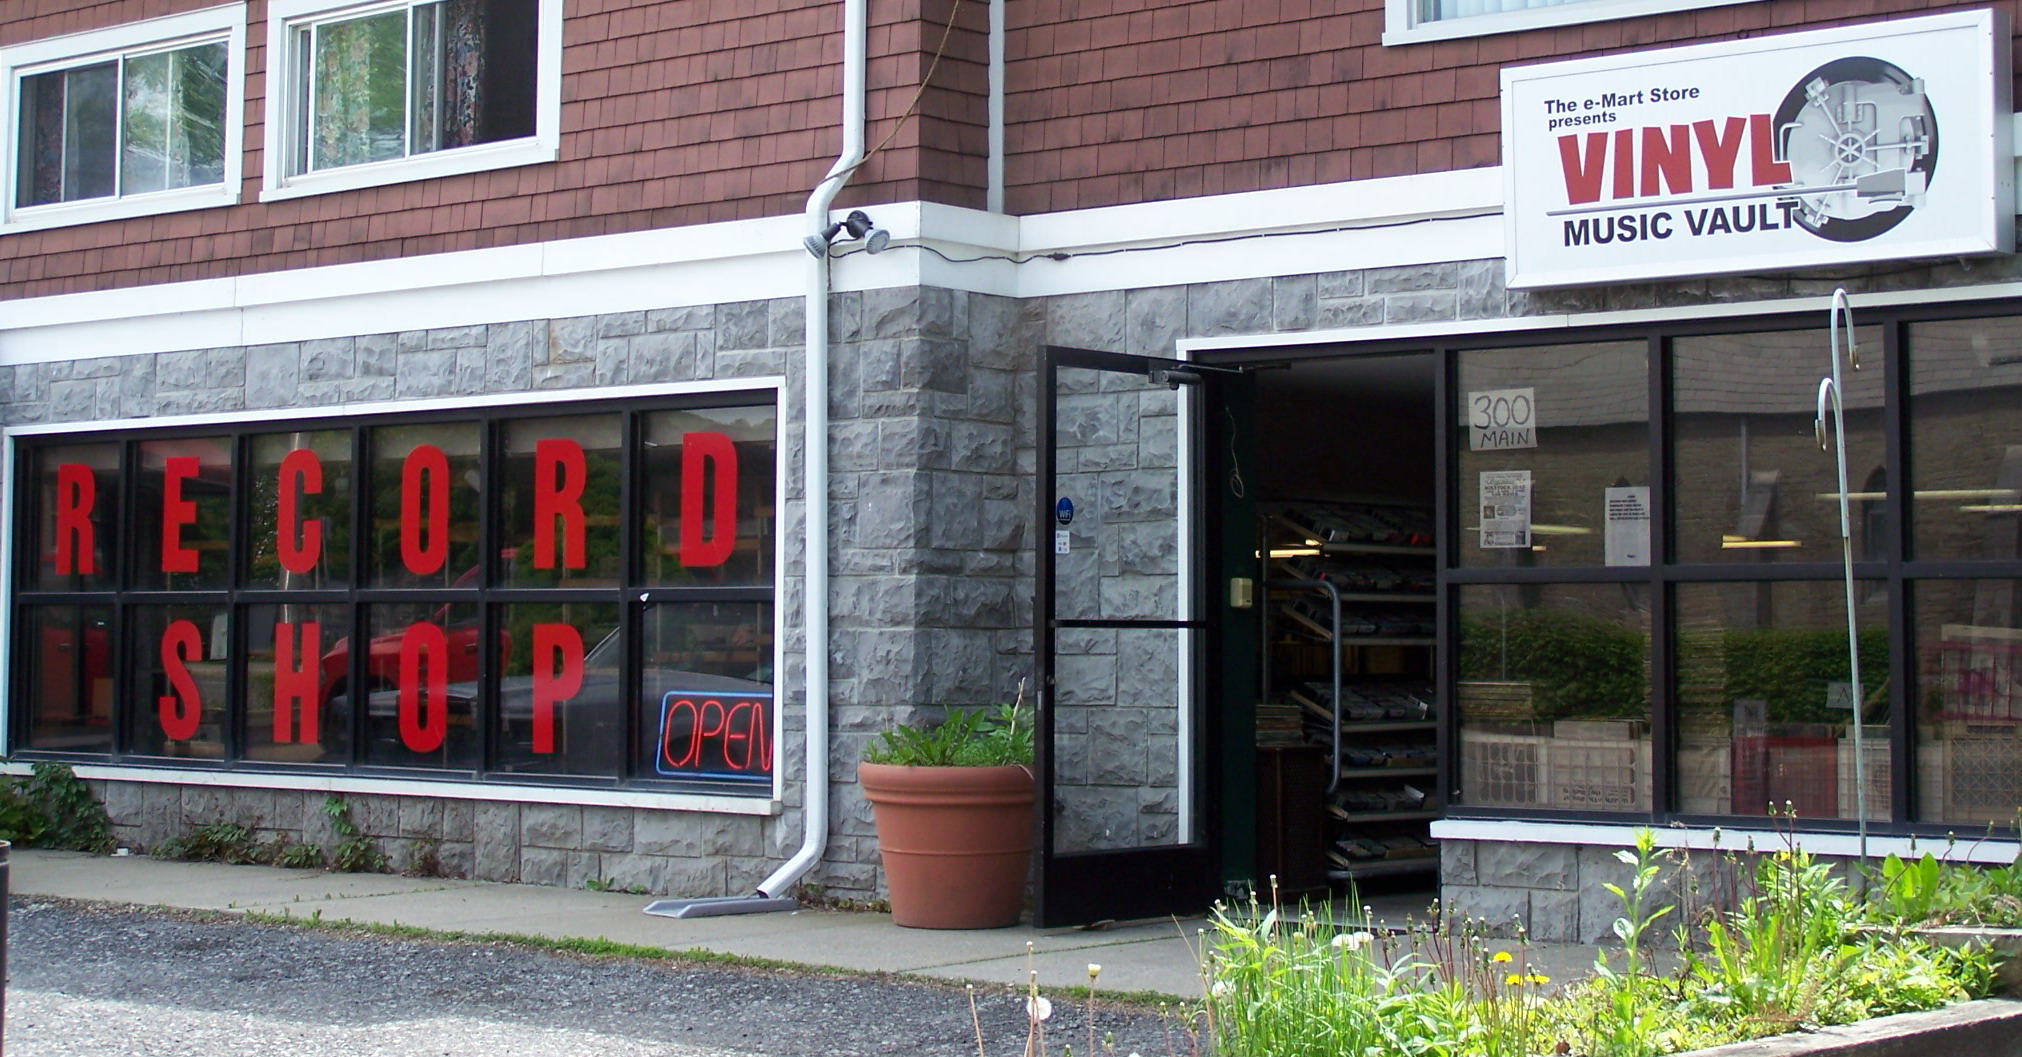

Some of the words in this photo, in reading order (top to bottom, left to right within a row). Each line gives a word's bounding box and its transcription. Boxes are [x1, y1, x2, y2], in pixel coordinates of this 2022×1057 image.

[1544, 98, 1578, 114] The
[1583, 89, 1644, 110] e-Mart
[1649, 86, 1701, 103] Store
[1548, 110, 1617, 131] presents
[1557, 113, 1794, 206] VINYL
[1563, 211, 1674, 247] MUSIC
[1684, 200, 1800, 237] VAULT
[1473, 394, 1531, 430] 300
[1480, 428, 1530, 448] MAIN
[55, 432, 738, 576] RECORD
[159, 619, 584, 755] SHOP
[664, 699, 772, 771] OPEN
